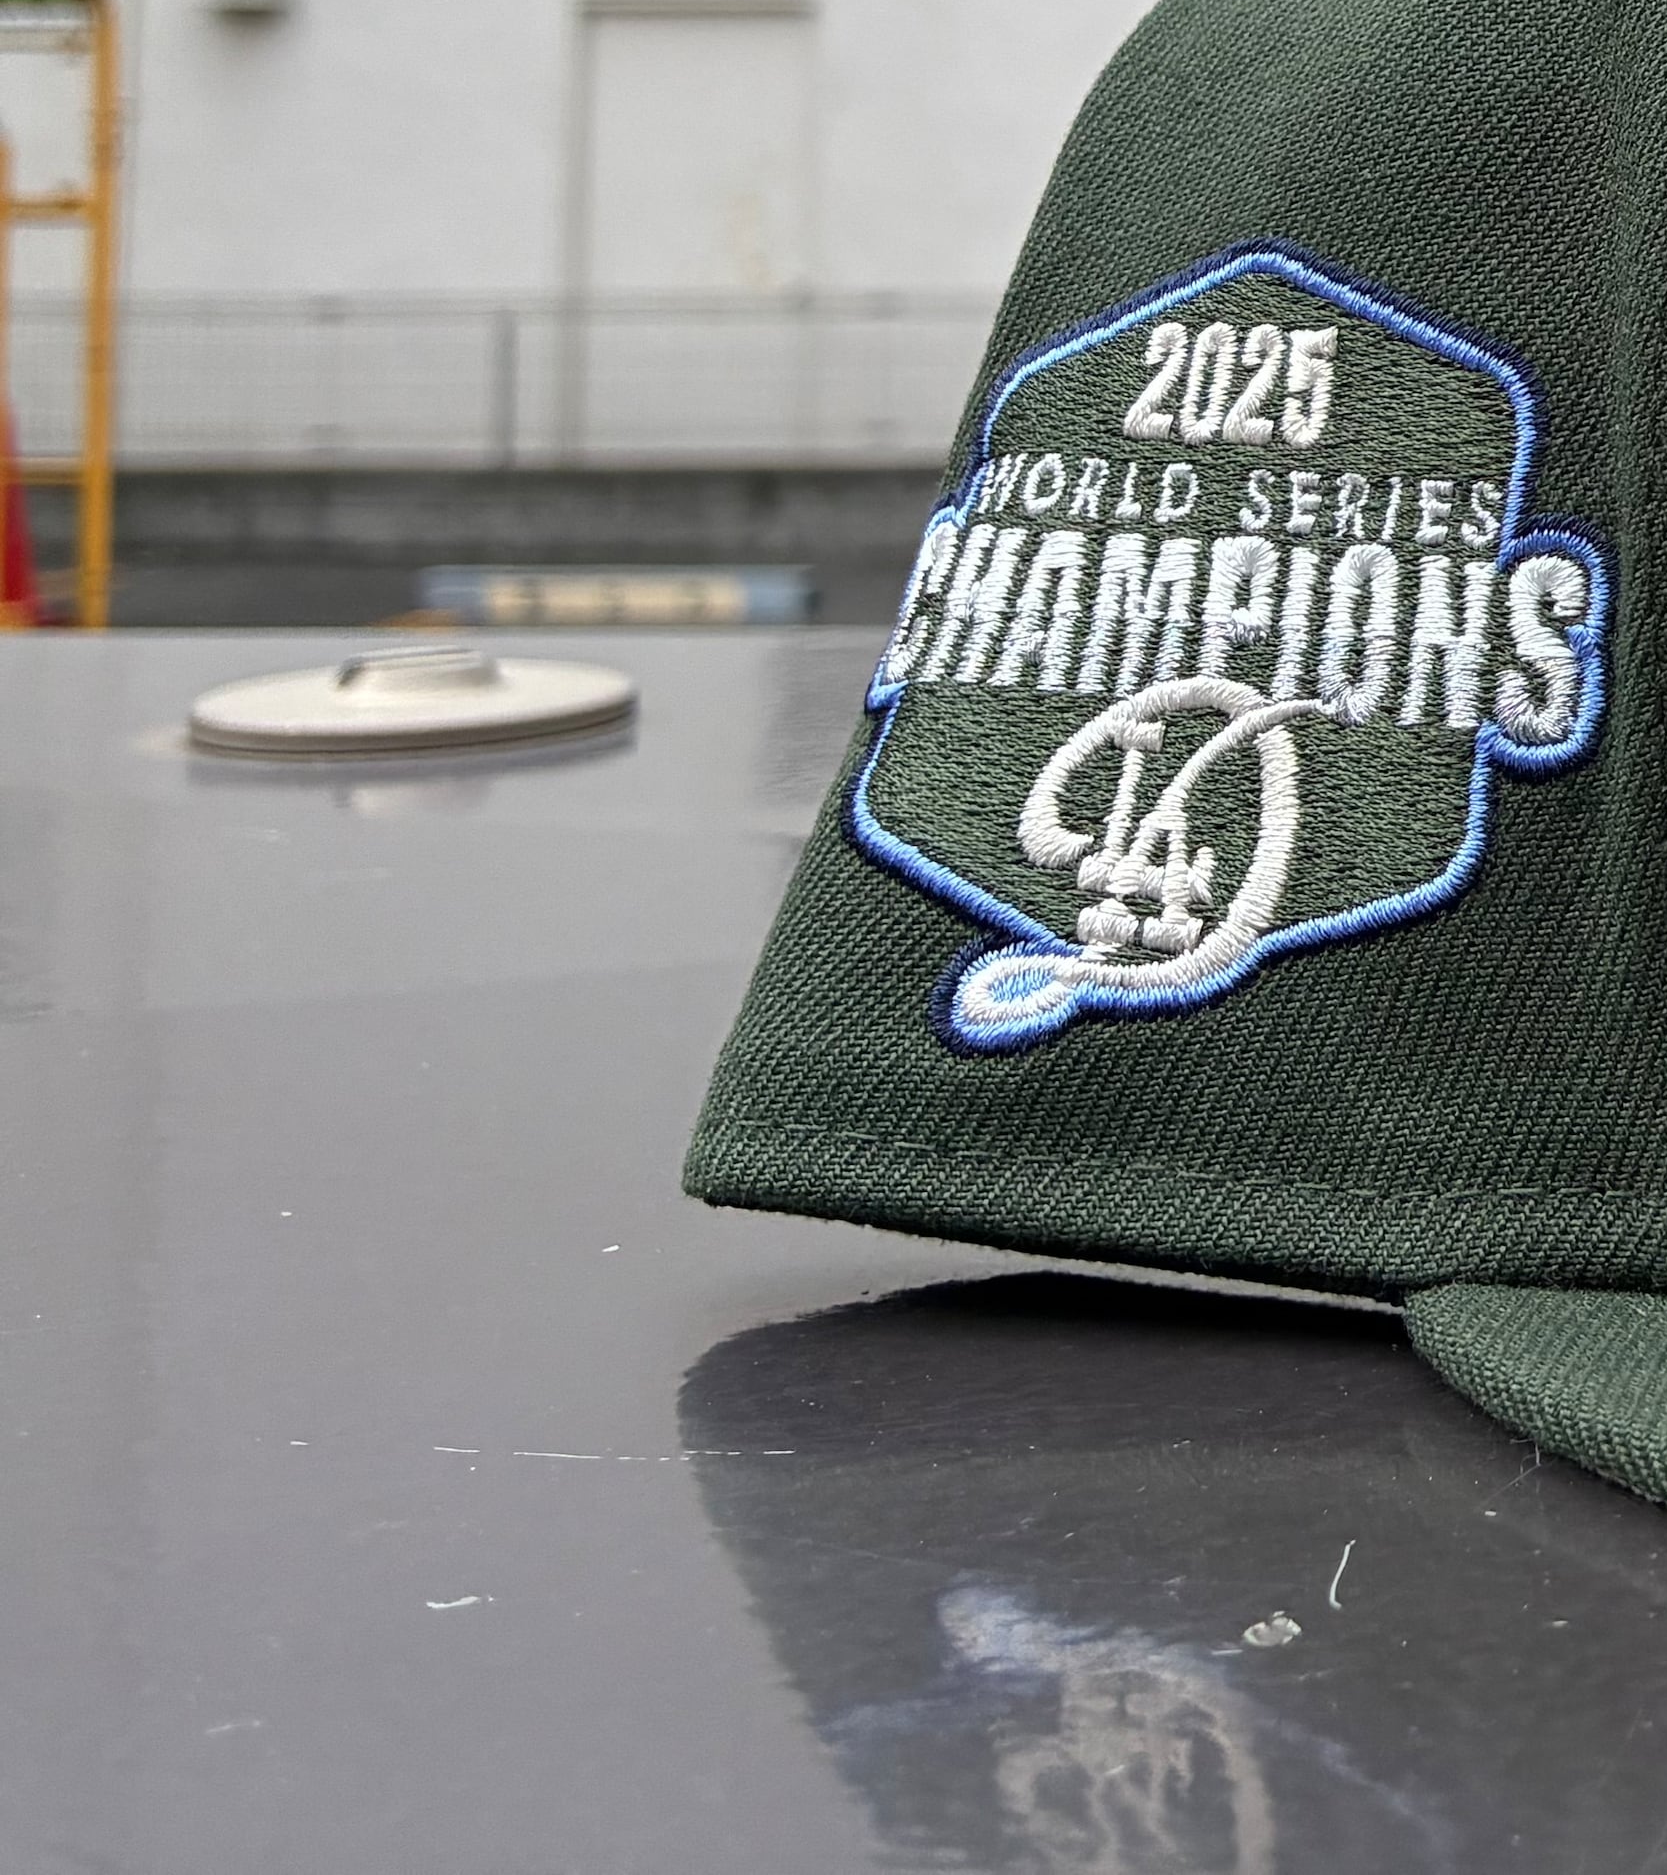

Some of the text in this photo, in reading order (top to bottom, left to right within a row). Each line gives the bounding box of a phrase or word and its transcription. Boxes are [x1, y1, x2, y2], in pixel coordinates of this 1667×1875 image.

[1123, 321, 1339, 446] 2025
[980, 452, 1505, 551] WORLD SERIES
[886, 523, 1588, 744] CHAMPIONS
